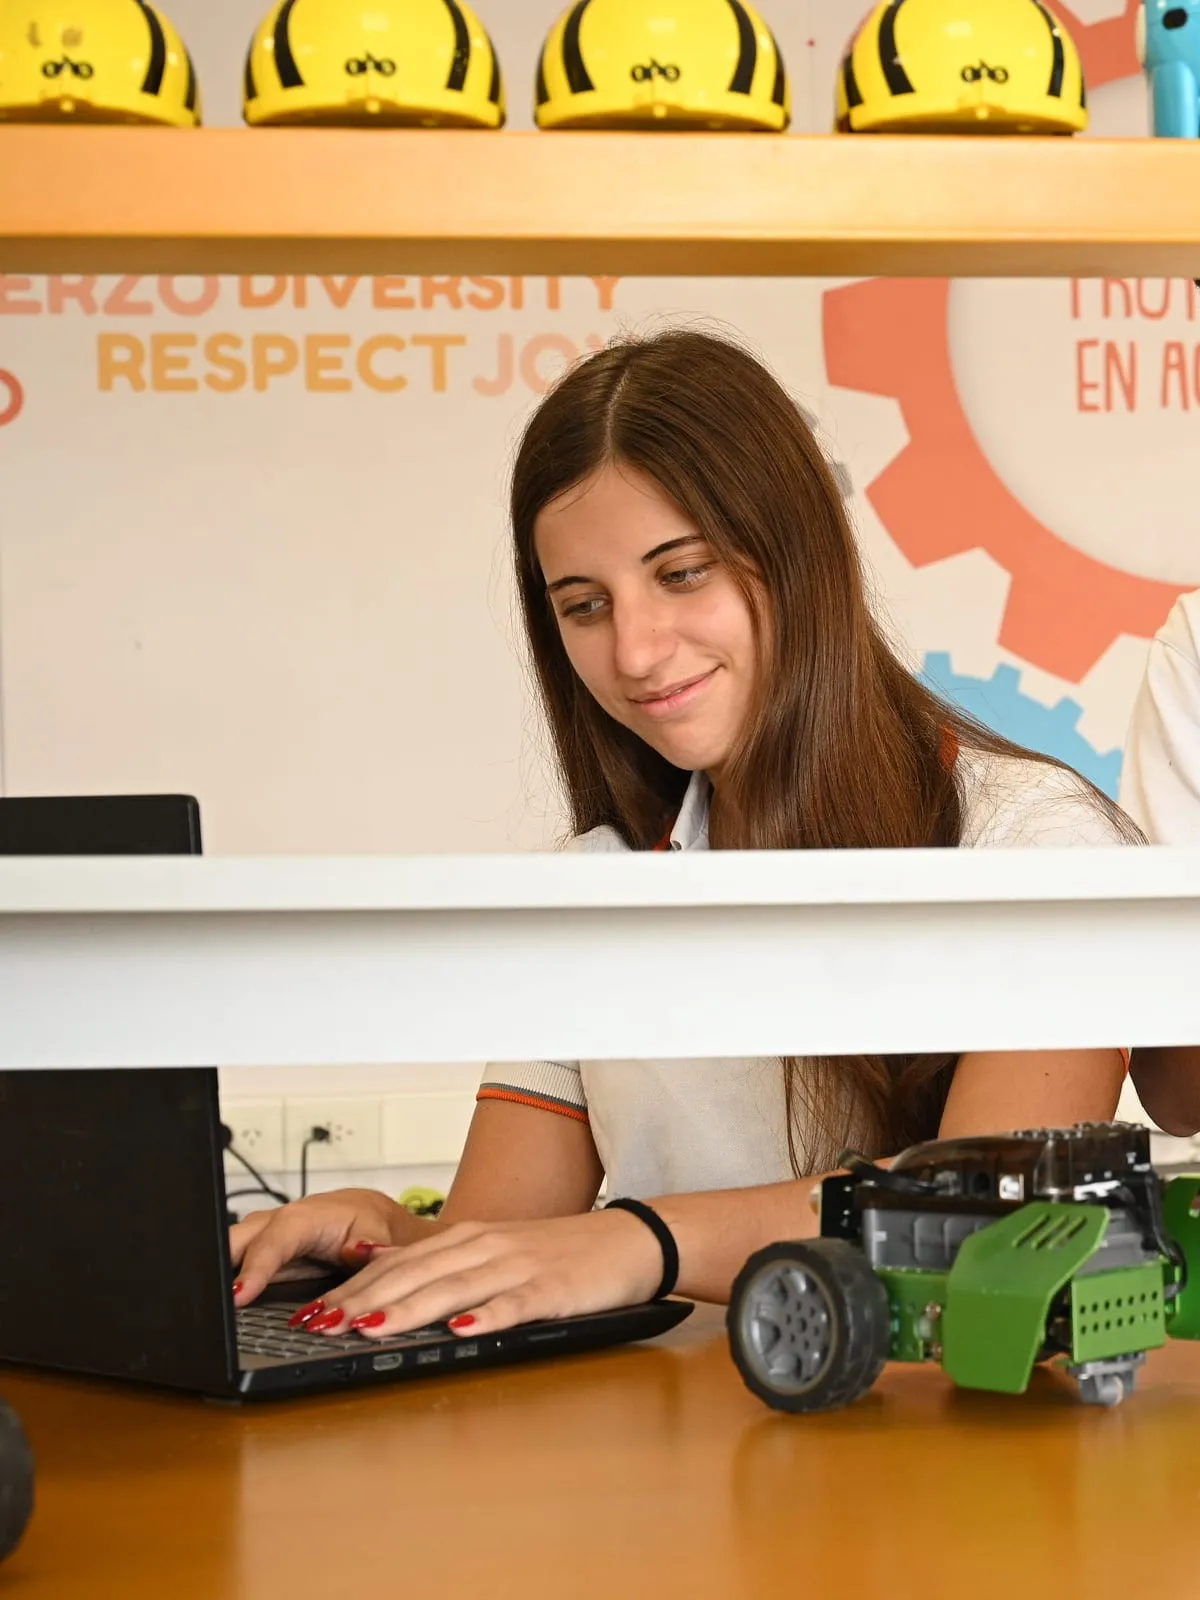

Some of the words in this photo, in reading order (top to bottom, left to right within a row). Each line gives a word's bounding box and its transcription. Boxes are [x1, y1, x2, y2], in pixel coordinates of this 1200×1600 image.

[97, 332, 467, 393] RESPECT
[472, 332, 606, 397] JO
[1076, 338, 1136, 413] EN
